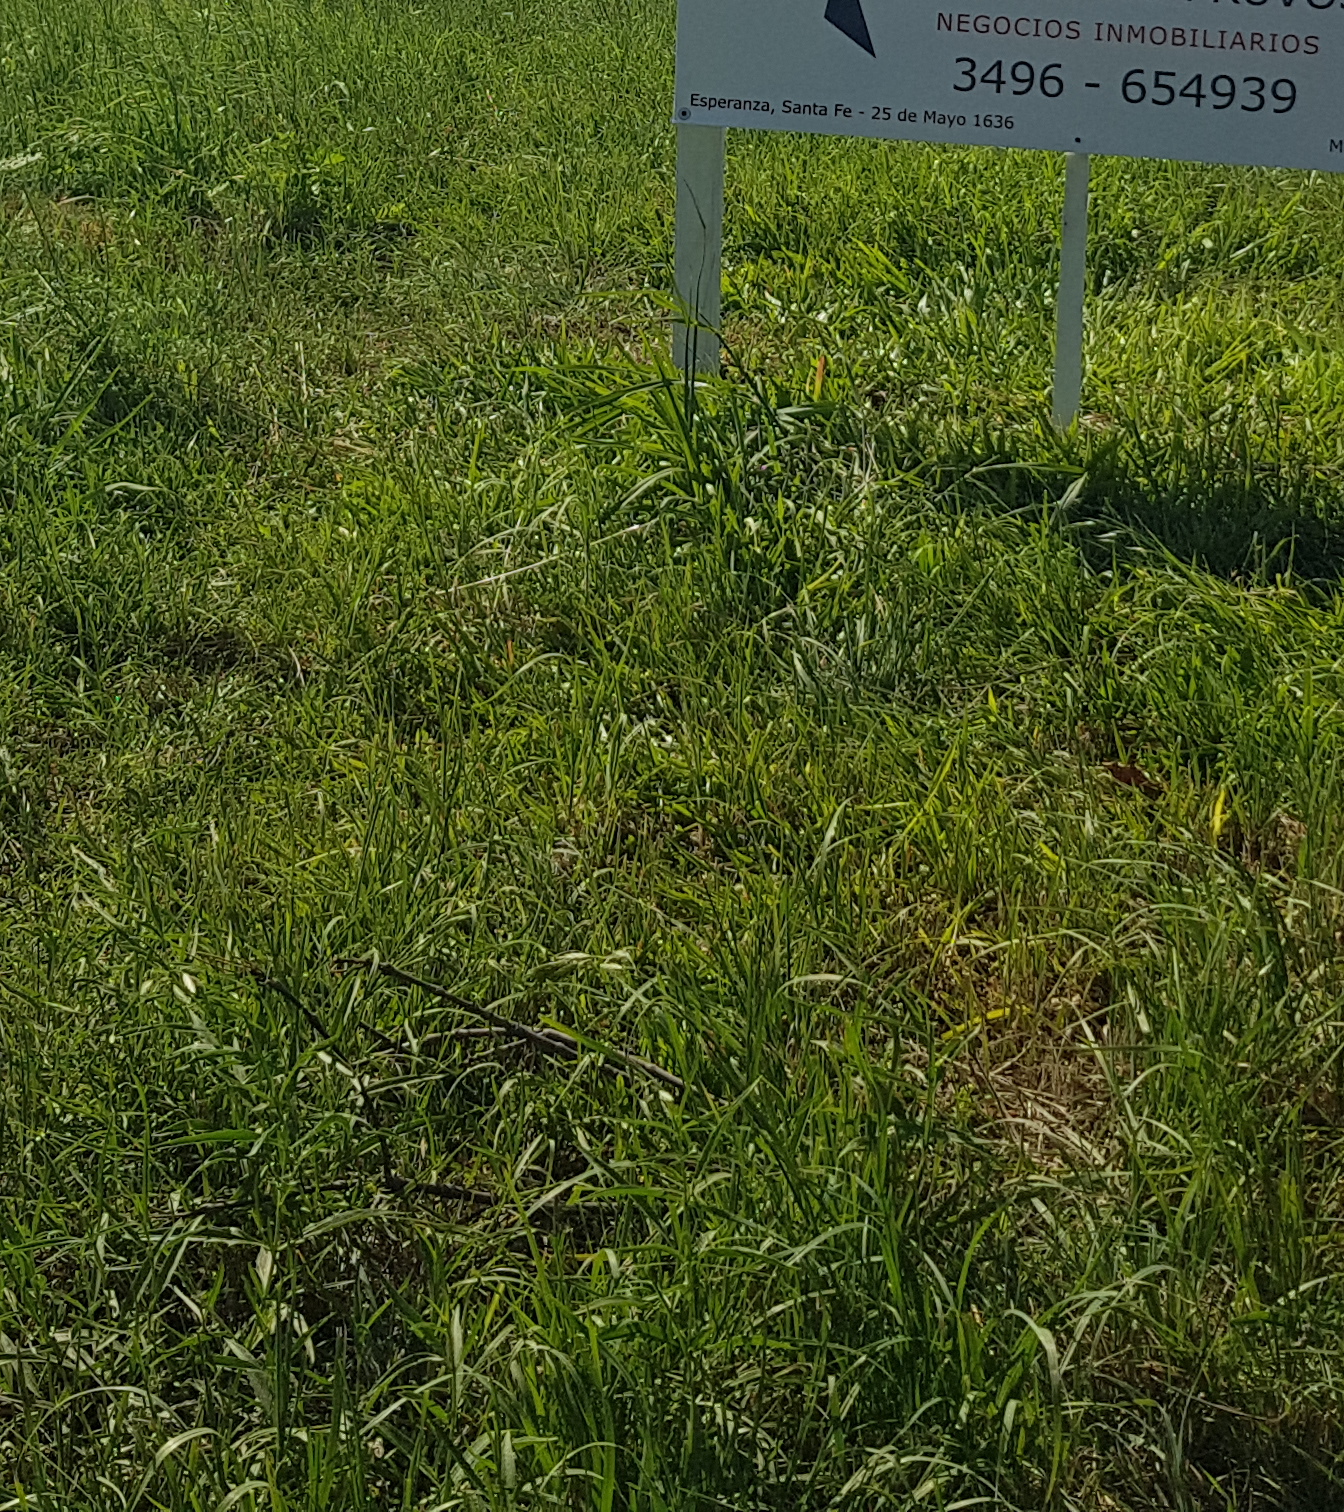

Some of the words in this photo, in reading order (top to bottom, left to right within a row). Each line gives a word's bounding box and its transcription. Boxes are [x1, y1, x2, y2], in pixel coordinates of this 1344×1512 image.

[936, 12, 1081, 40] NEGOCIOS
[1094, 22, 1320, 55] INMOBILIARIOS
[952, 56, 1064, 98] 3496
[1121, 68, 1297, 114] 654939
[690, 93, 775, 115] Esperanza,
[781, 99, 828, 117] Santa
[834, 103, 853, 118] Fe
[871, 106, 892, 121] 25
[897, 107, 918, 123] de
[923, 110, 967, 129] Mayo
[973, 113, 1015, 130] 1636
